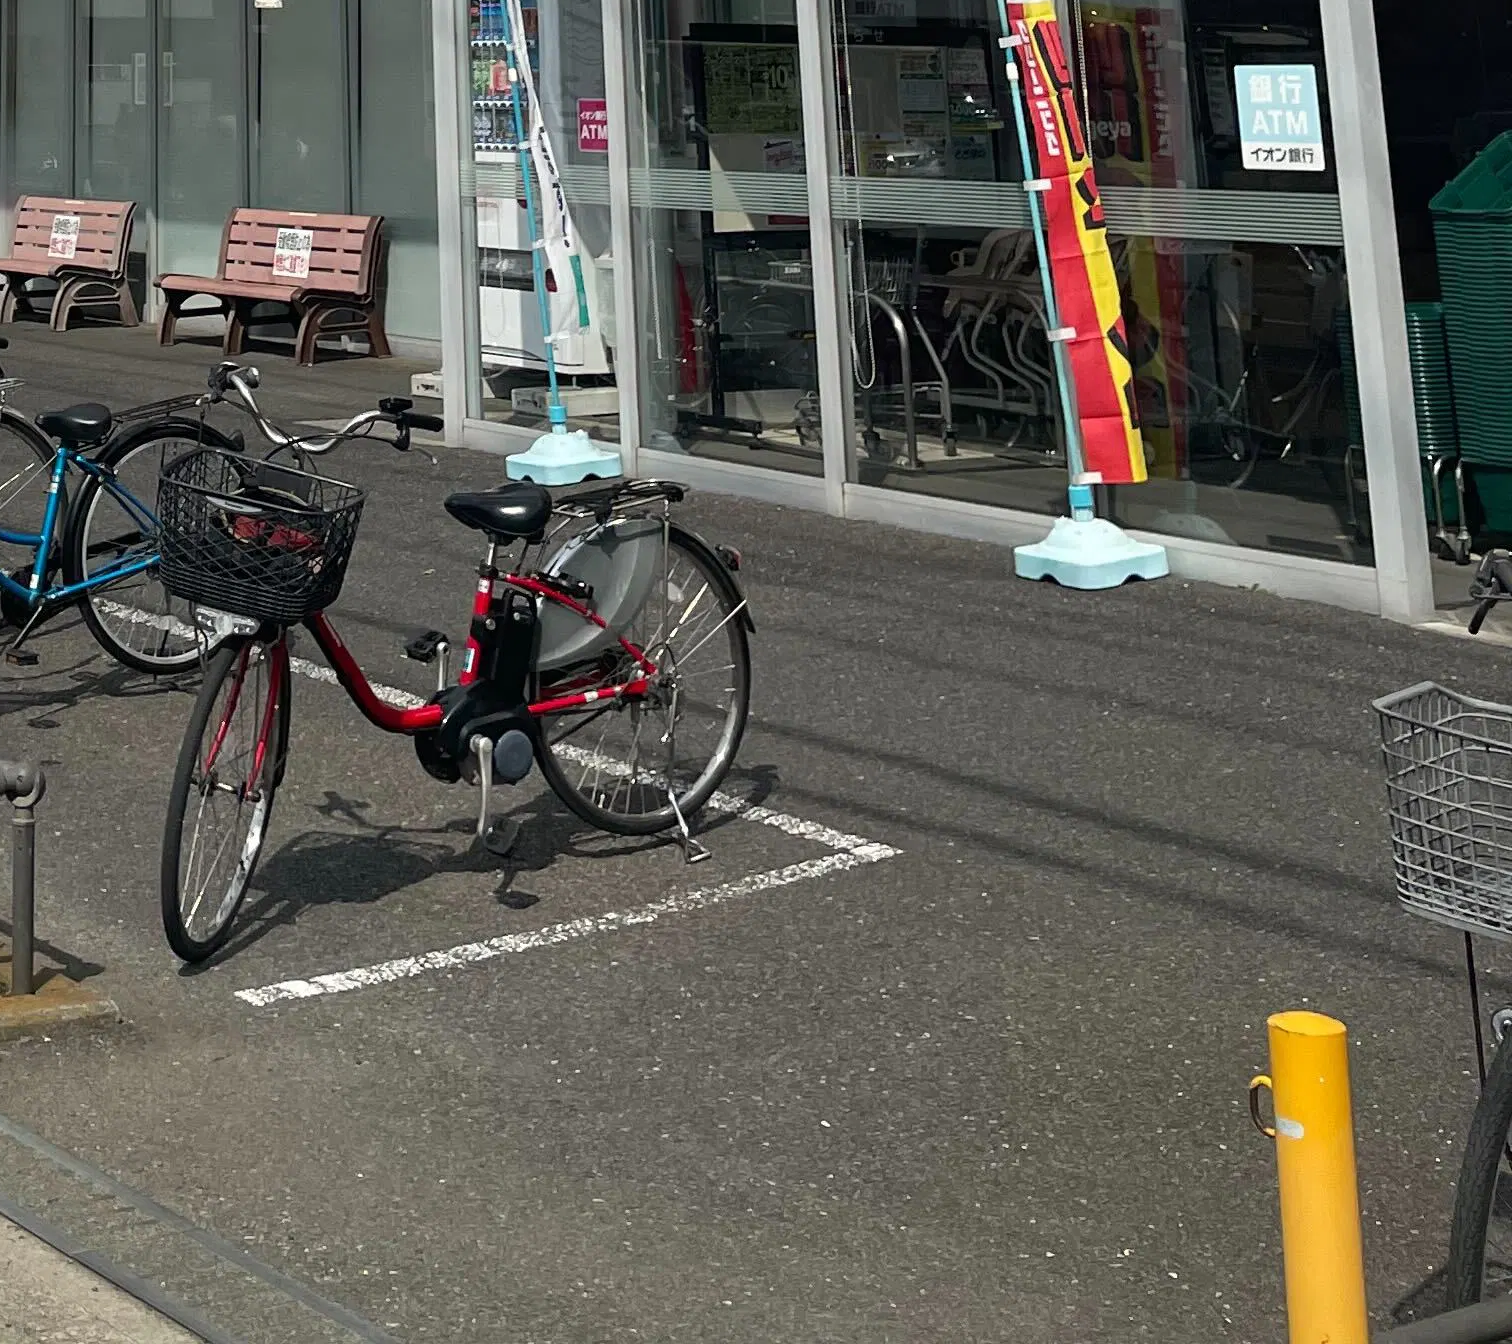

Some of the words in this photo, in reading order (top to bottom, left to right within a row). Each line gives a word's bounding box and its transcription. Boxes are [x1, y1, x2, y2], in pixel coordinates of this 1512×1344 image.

[1248, 74, 1303, 105] 銀行
[581, 124, 607, 140] ATM
[1252, 109, 1308, 135] ATM
[1250, 147, 1314, 164] イオン銀行
